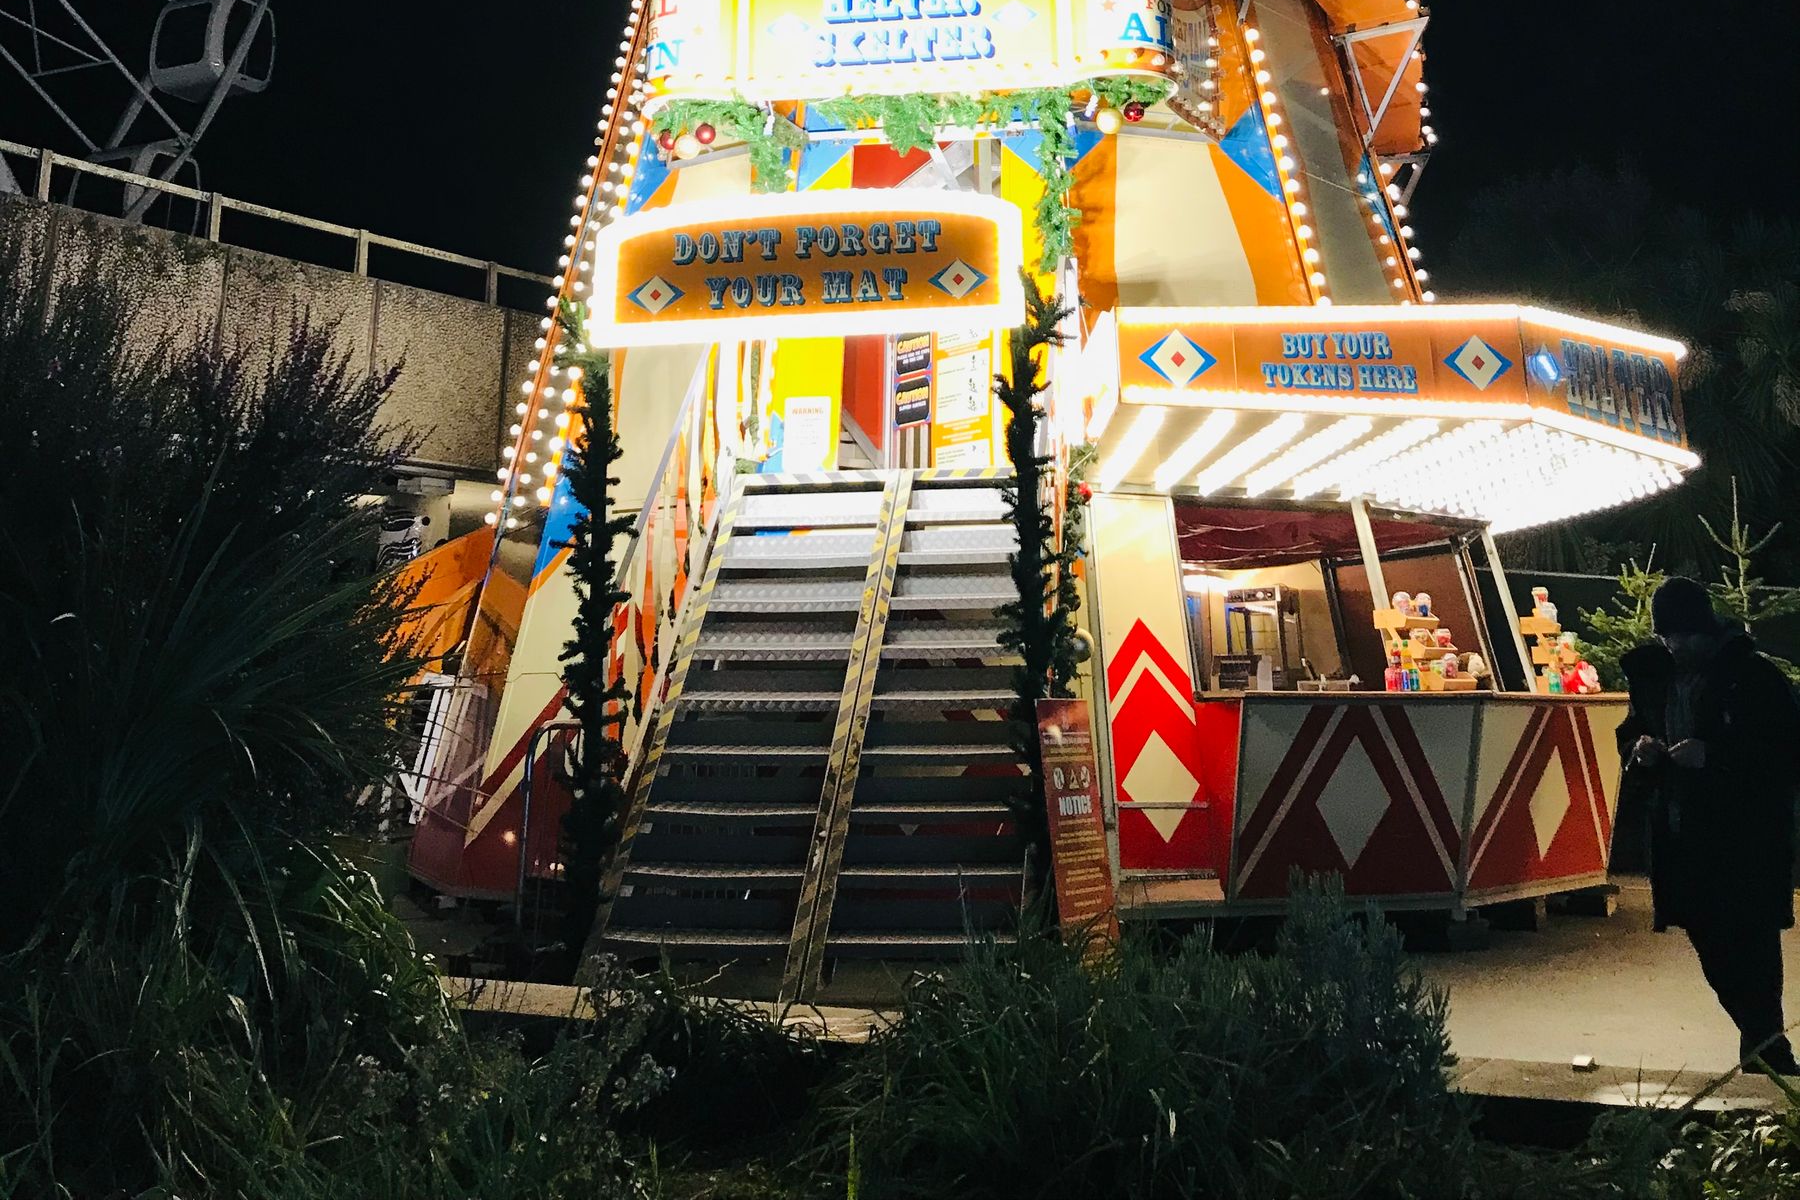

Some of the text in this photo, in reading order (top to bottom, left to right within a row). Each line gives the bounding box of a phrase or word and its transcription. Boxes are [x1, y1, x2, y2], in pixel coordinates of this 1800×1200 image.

[814, 25, 996, 67] SKELTER
[672, 219, 942, 266] DON'T FORGET
[704, 267, 908, 310] YOUR MAT
[897, 333, 930, 355] CAUTION
[1280, 331, 1392, 359] BUY YOUR
[1260, 362, 1418, 394] TOKENS HERE
[1560, 338, 1682, 444] HELTER
[791, 406, 824, 415] WARNING
[896, 385, 929, 406] CAUTION
[1058, 795, 1092, 816] NOTICE
